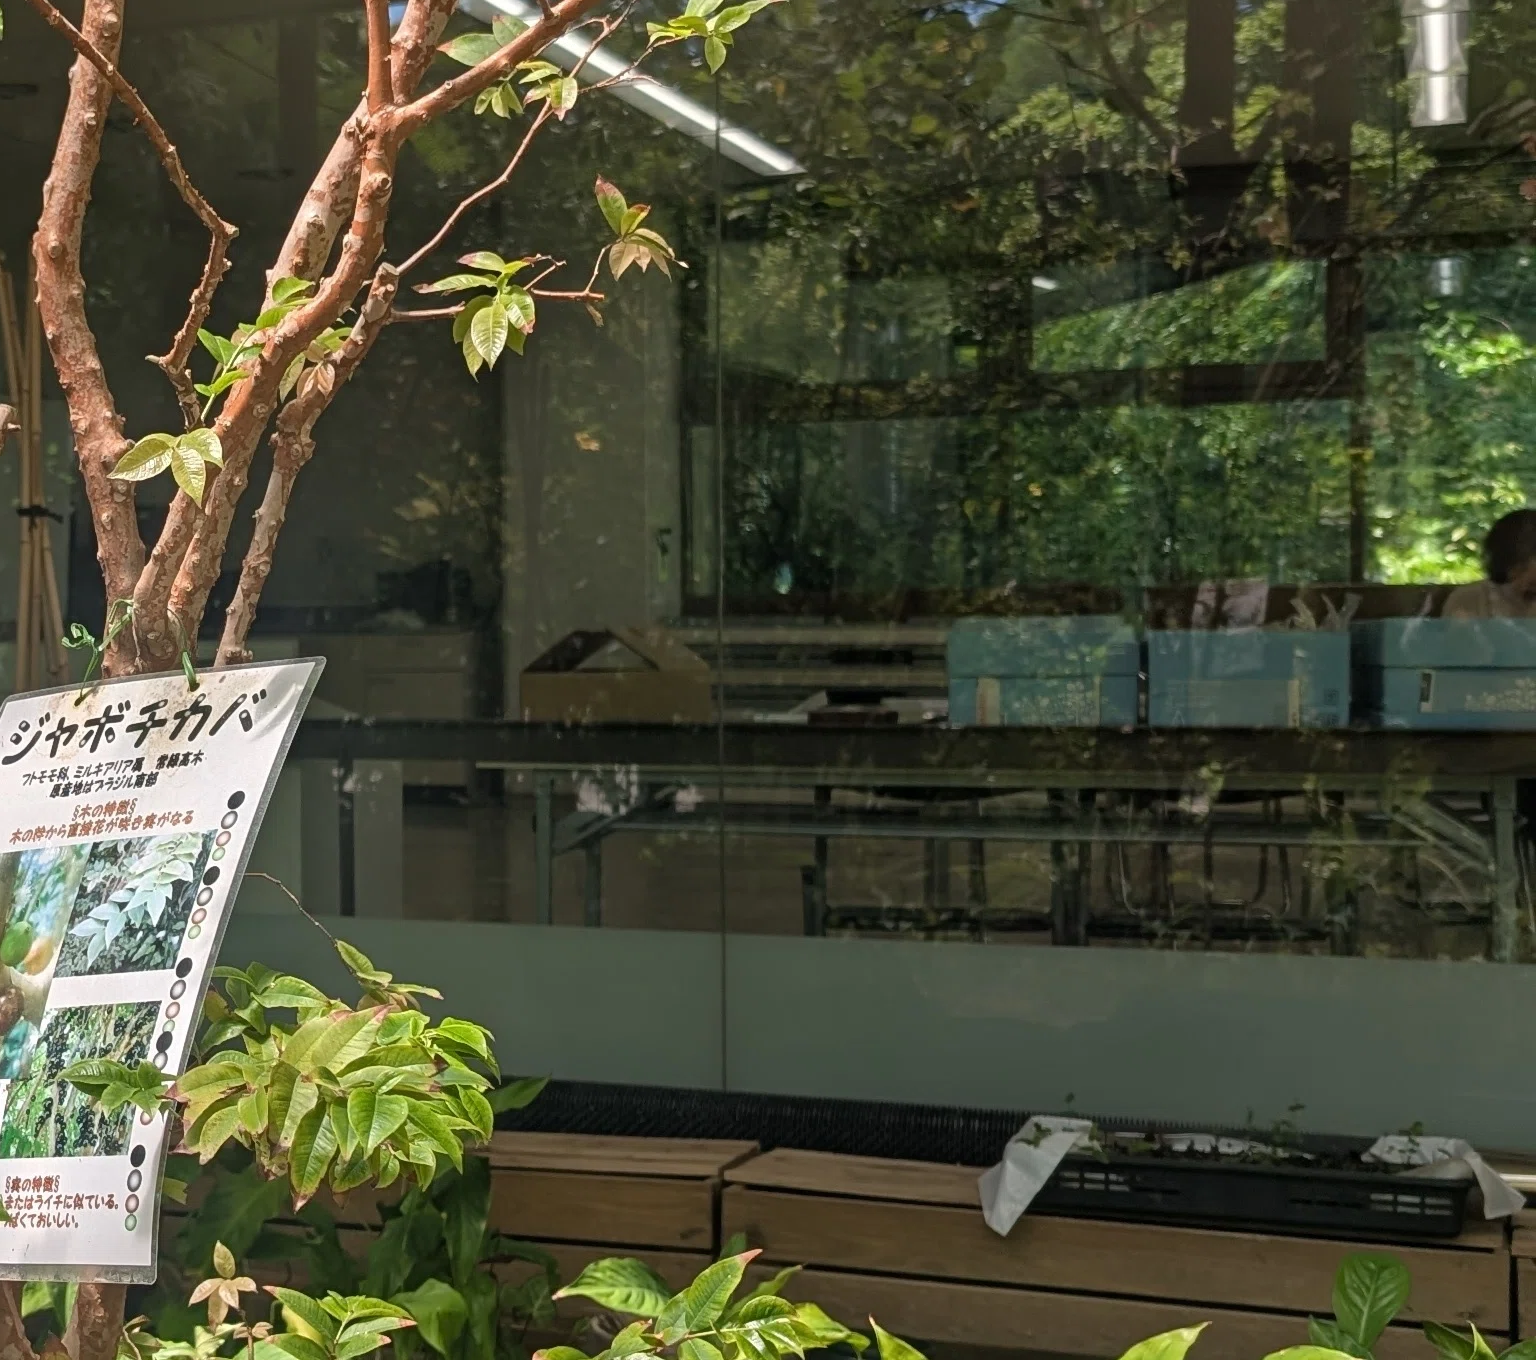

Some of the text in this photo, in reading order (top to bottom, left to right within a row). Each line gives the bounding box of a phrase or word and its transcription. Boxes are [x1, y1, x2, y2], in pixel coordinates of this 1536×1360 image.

[1, 688, 268, 766] ジャボチカバ
[0, 1192, 120, 1211] またはライチに似ている。
